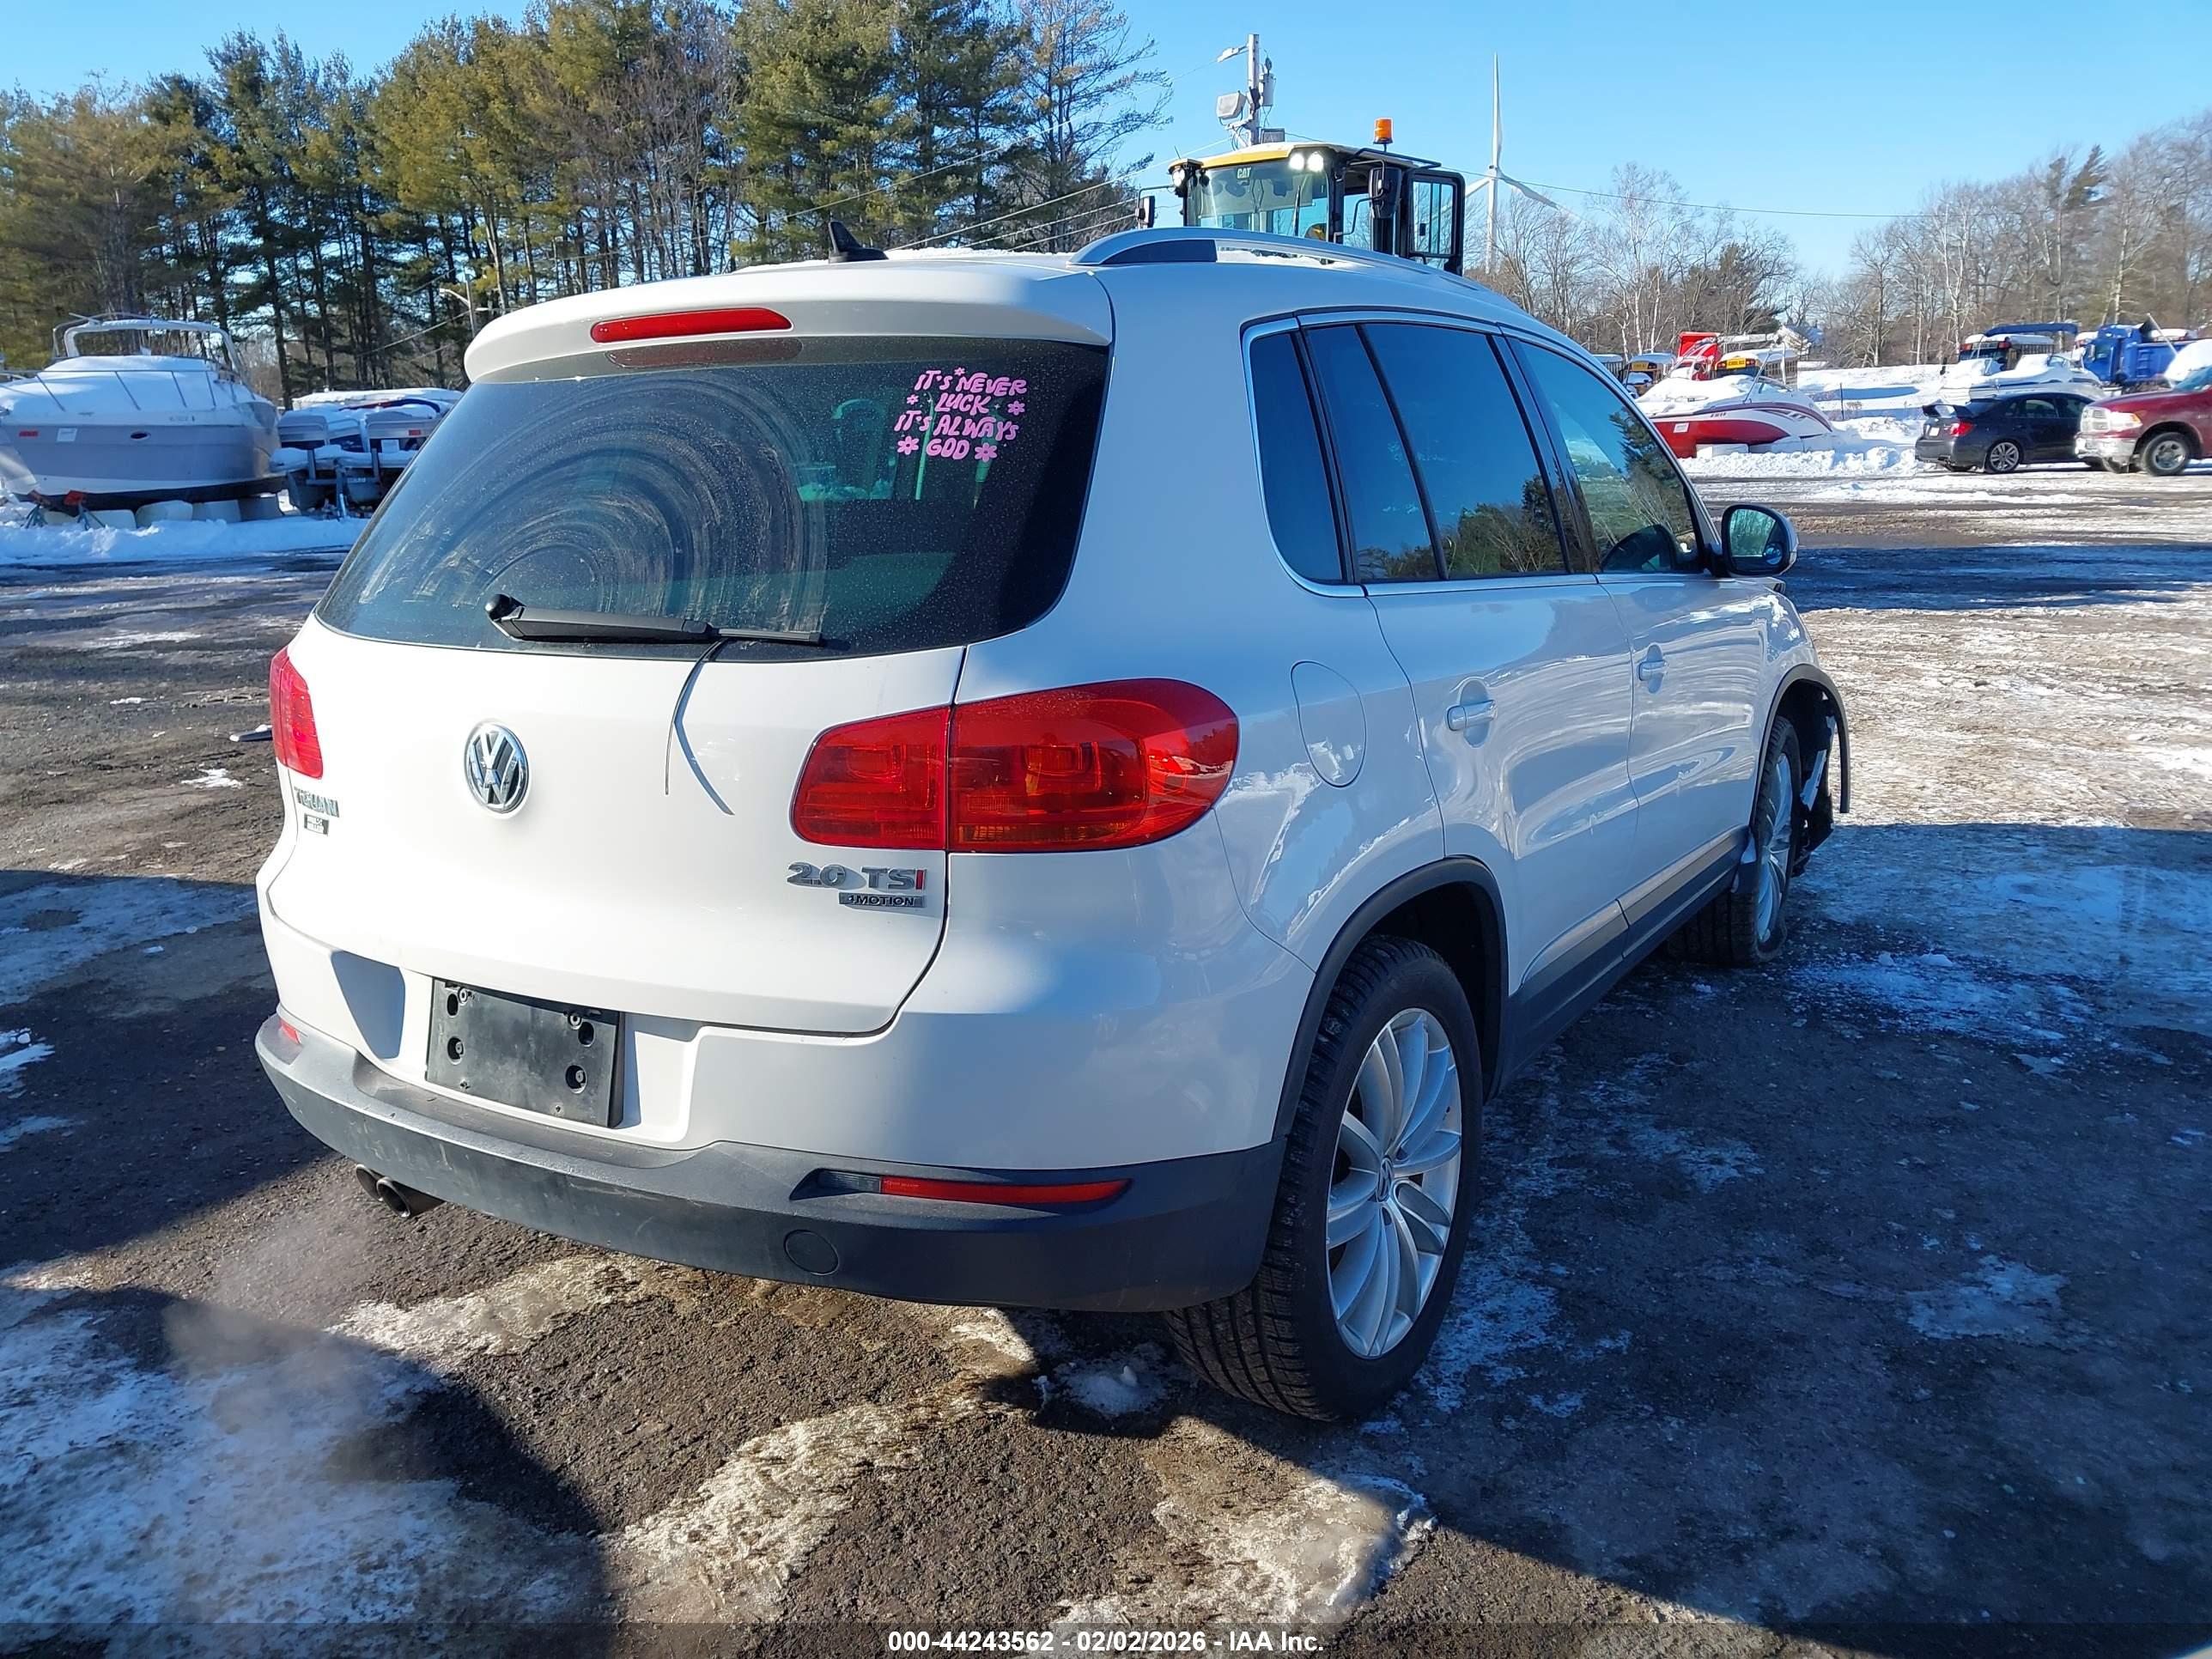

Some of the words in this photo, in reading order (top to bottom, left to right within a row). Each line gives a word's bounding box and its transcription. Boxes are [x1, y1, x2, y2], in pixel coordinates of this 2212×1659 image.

[1237, 167, 1252, 179] CAT
[914, 369, 953, 391] IT'S
[955, 372, 1028, 397] NEVER
[934, 392, 992, 416] LUCK
[893, 410, 933, 432] IT'S
[933, 414, 1020, 441] ALWAYS
[926, 437, 970, 460] GOD
[465, 724, 528, 812] VW
[861, 866, 927, 890] TSI
[848, 894, 915, 907] 4MOTION
